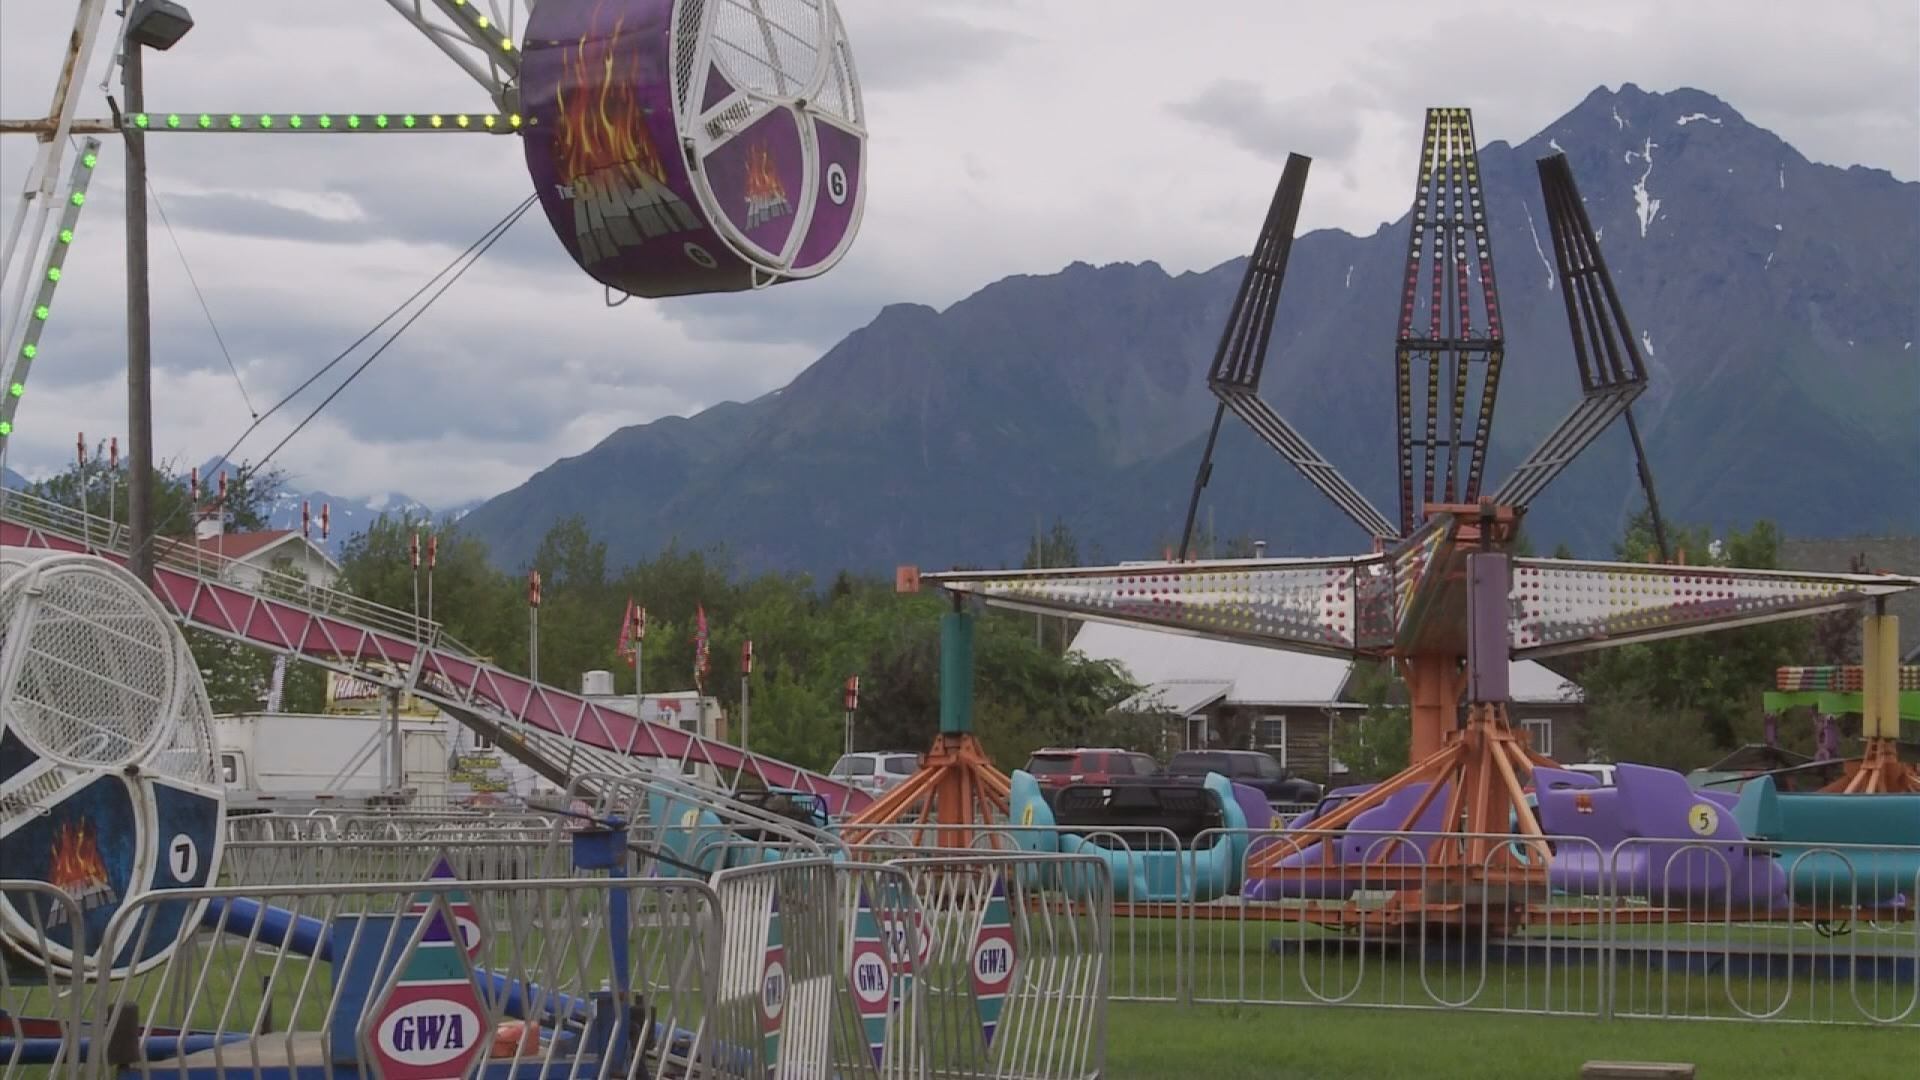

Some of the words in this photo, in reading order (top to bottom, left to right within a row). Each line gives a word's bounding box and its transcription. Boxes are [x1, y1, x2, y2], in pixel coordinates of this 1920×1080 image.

[832, 171, 843, 196] 6
[1700, 813, 1710, 831] 5
[175, 843, 191, 874] 7
[978, 948, 1008, 975] GWA
[857, 963, 885, 992] GWA
[392, 1013, 465, 1052] GWA
